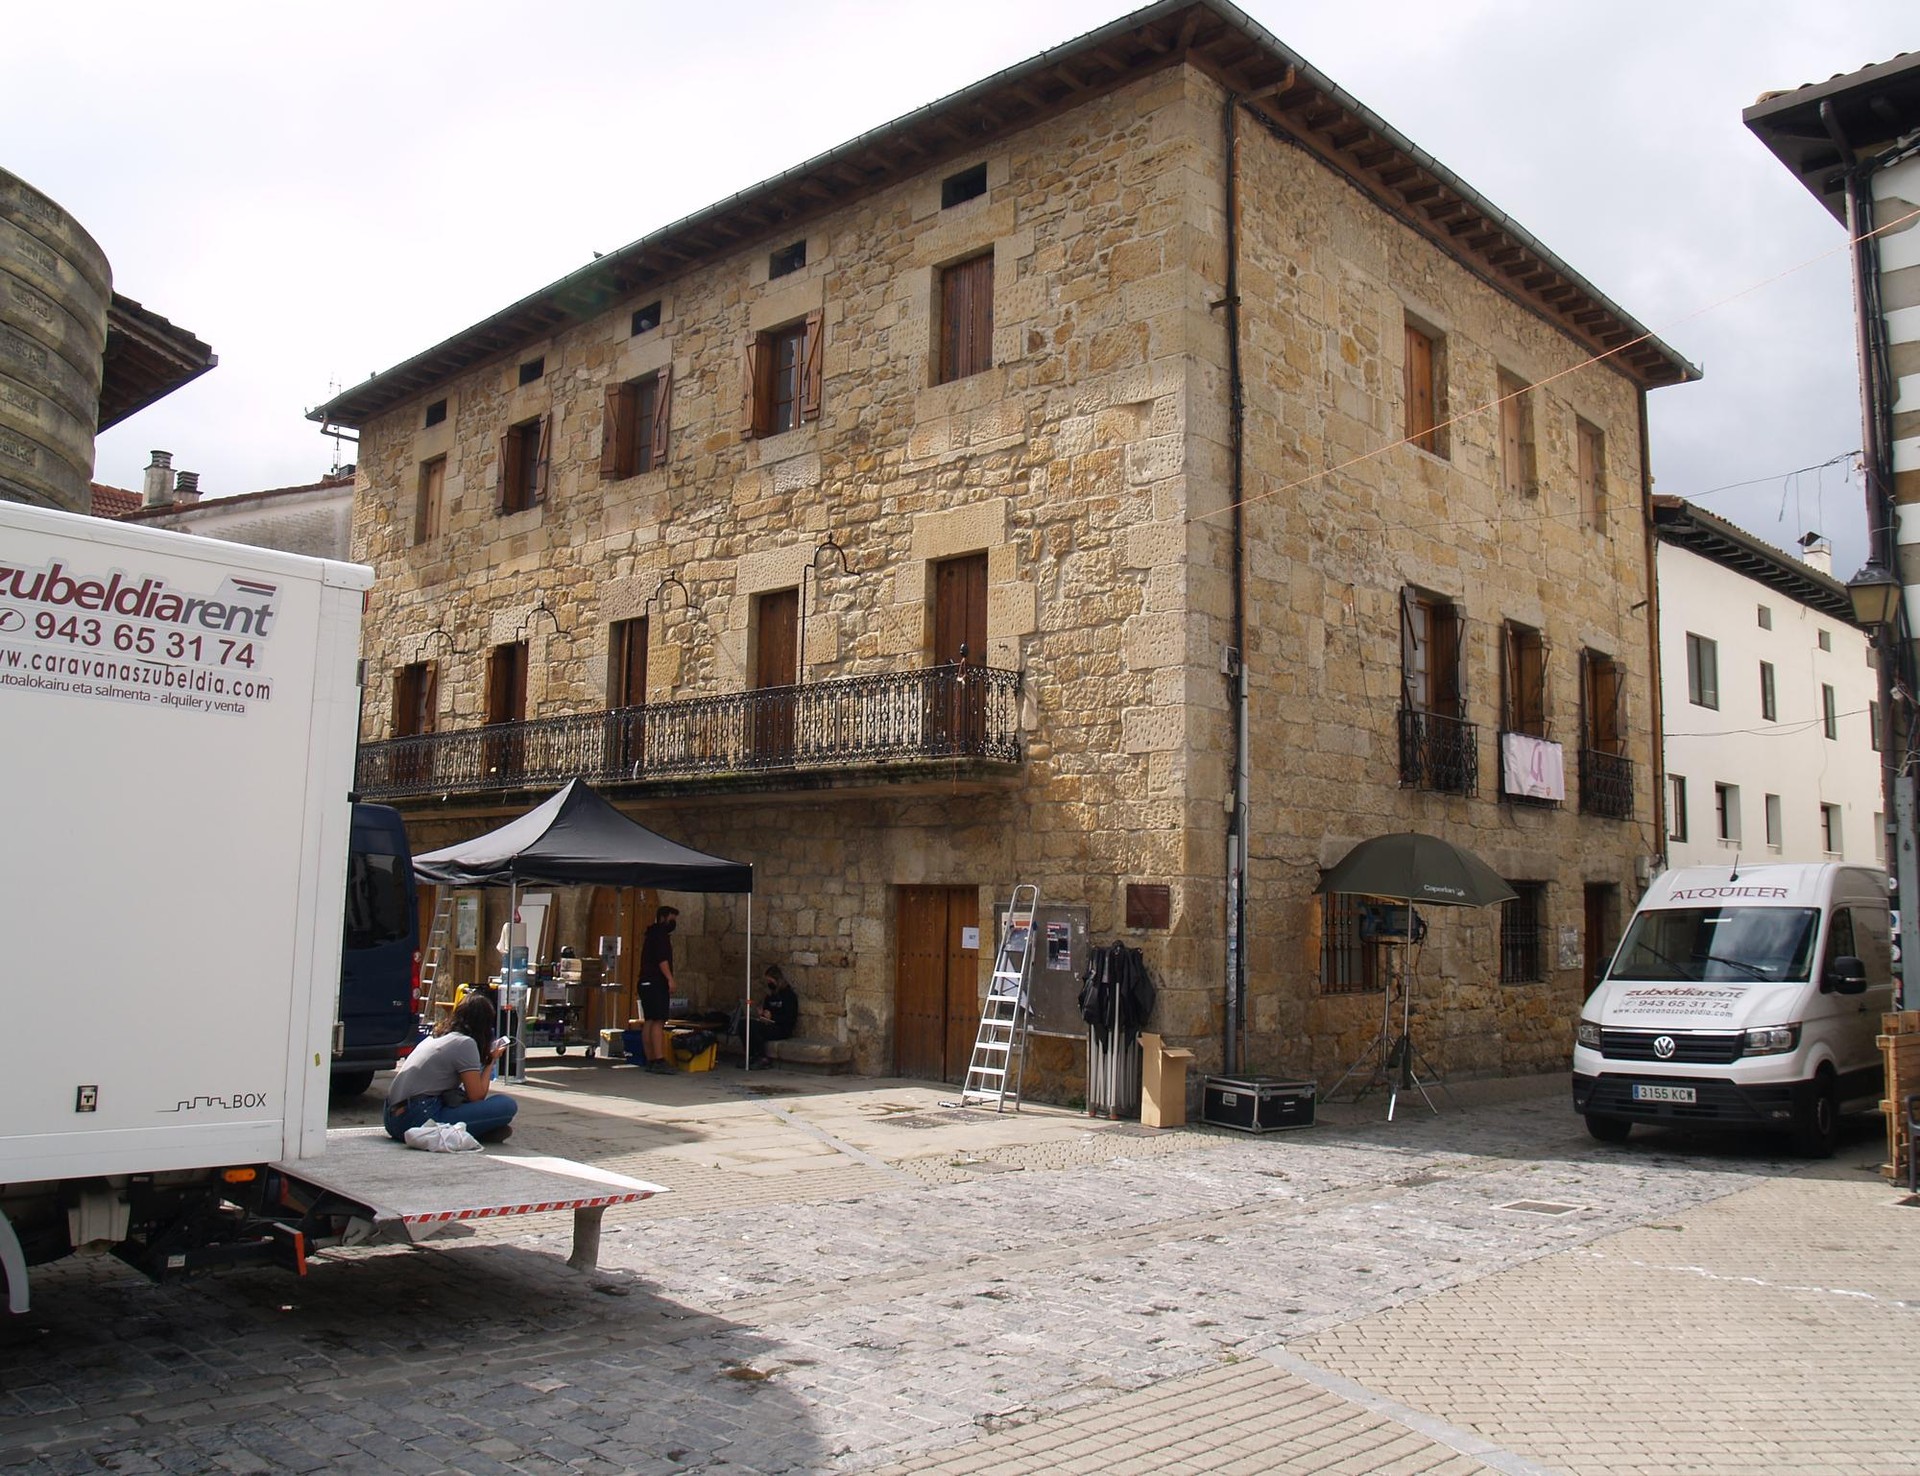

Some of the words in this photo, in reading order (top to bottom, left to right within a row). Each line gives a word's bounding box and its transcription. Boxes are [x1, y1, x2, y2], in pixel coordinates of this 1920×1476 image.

[0, 564, 274, 637] zubeldiarent
[35, 611, 102, 647] 943
[113, 624, 155, 654] 65
[166, 632, 202, 661] 31
[218, 639, 255, 669] 74
[72, 682, 93, 695] eta
[95, 685, 151, 701] salmenta
[160, 692, 203, 708] alquiler
[204, 700, 213, 712] y
[214, 702, 245, 714] venta
[1669, 887, 1788, 901] ALQUILER
[1624, 987, 1744, 999] zubeldiarent
[1638, 999, 1665, 1007] 943
[1668, 1000, 1685, 1008] 65
[1688, 1001, 1707, 1009] 31
[1711, 1002, 1729, 1010] 74
[1640, 1087, 1669, 1099] 3155
[232, 1093, 267, 1109] BOX
